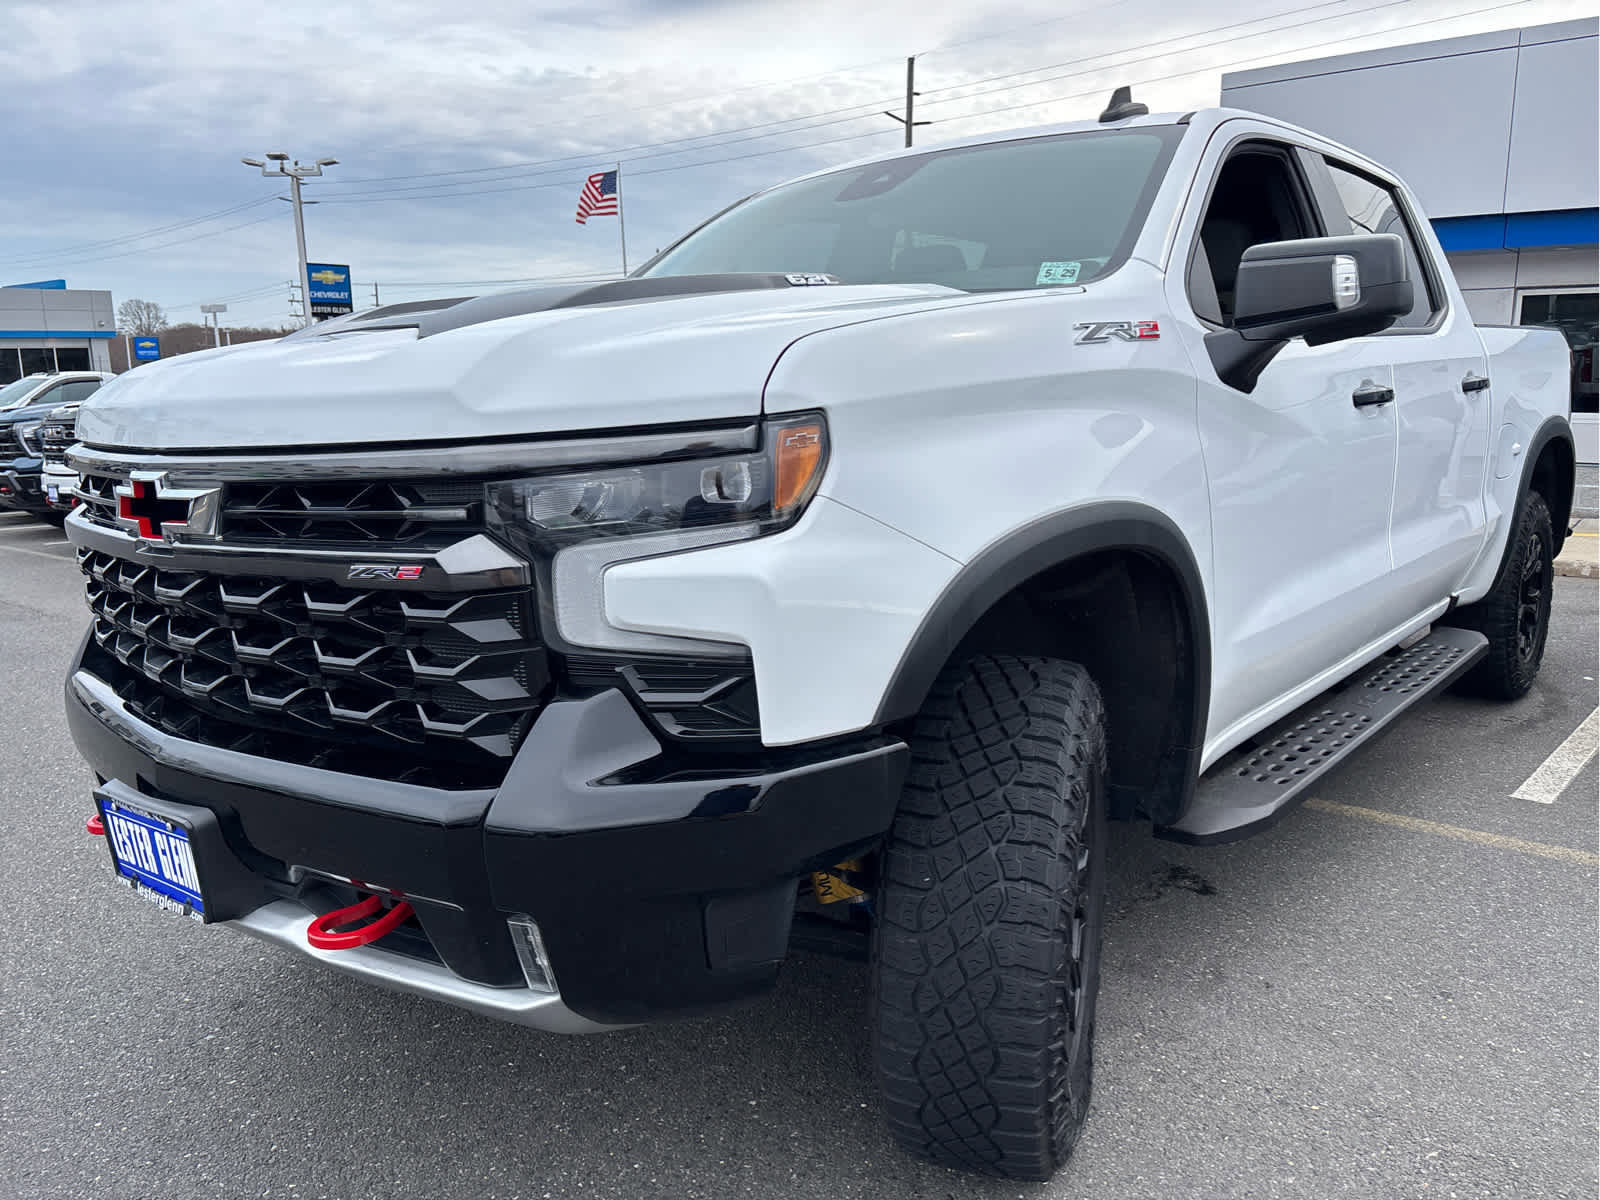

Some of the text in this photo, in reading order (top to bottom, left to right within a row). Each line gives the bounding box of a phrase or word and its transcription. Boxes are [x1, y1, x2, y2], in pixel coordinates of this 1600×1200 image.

[310, 291, 349, 299] CHEVROLET
[1072, 320, 1160, 346] ZR2
[347, 565, 424, 580] ZR2
[106, 813, 202, 895] LESTER GLENN
